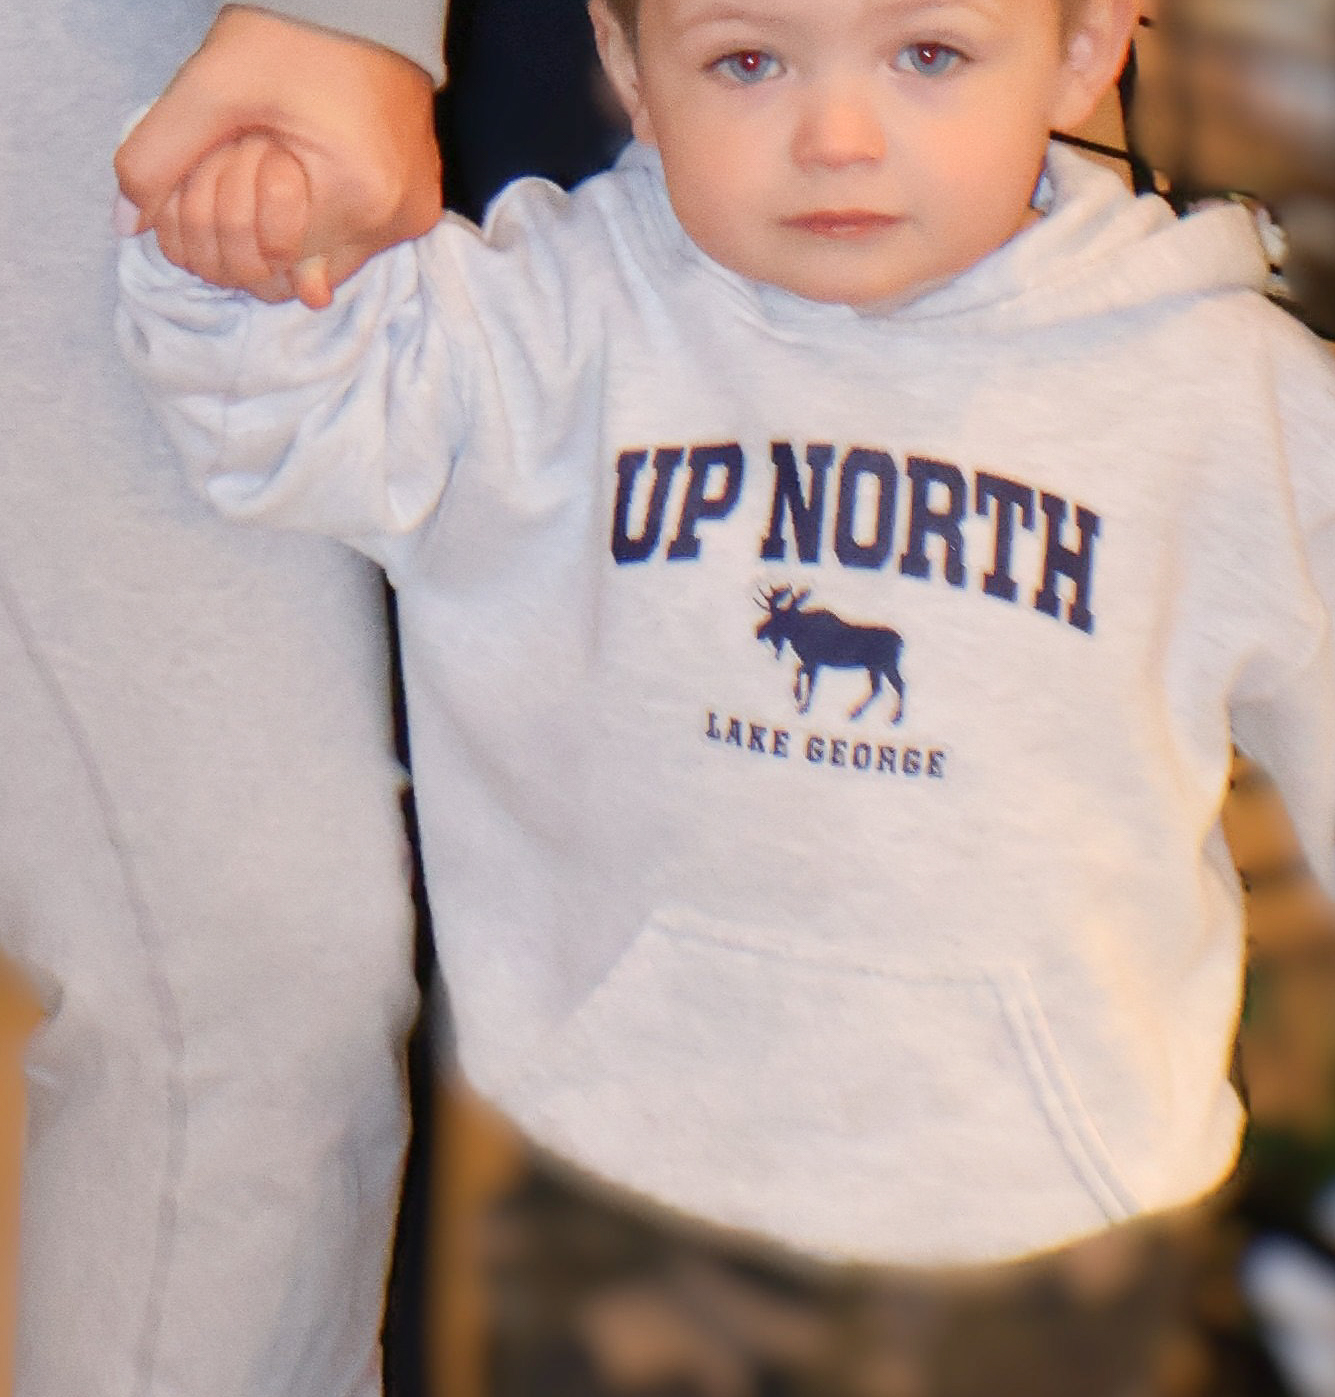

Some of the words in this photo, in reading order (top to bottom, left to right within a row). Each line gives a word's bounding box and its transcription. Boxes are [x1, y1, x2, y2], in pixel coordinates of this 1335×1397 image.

[611, 443, 744, 564] UP
[760, 442, 1102, 635] NORTH
[706, 711, 790, 758] LAKE
[804, 734, 948, 778] GEORGE
